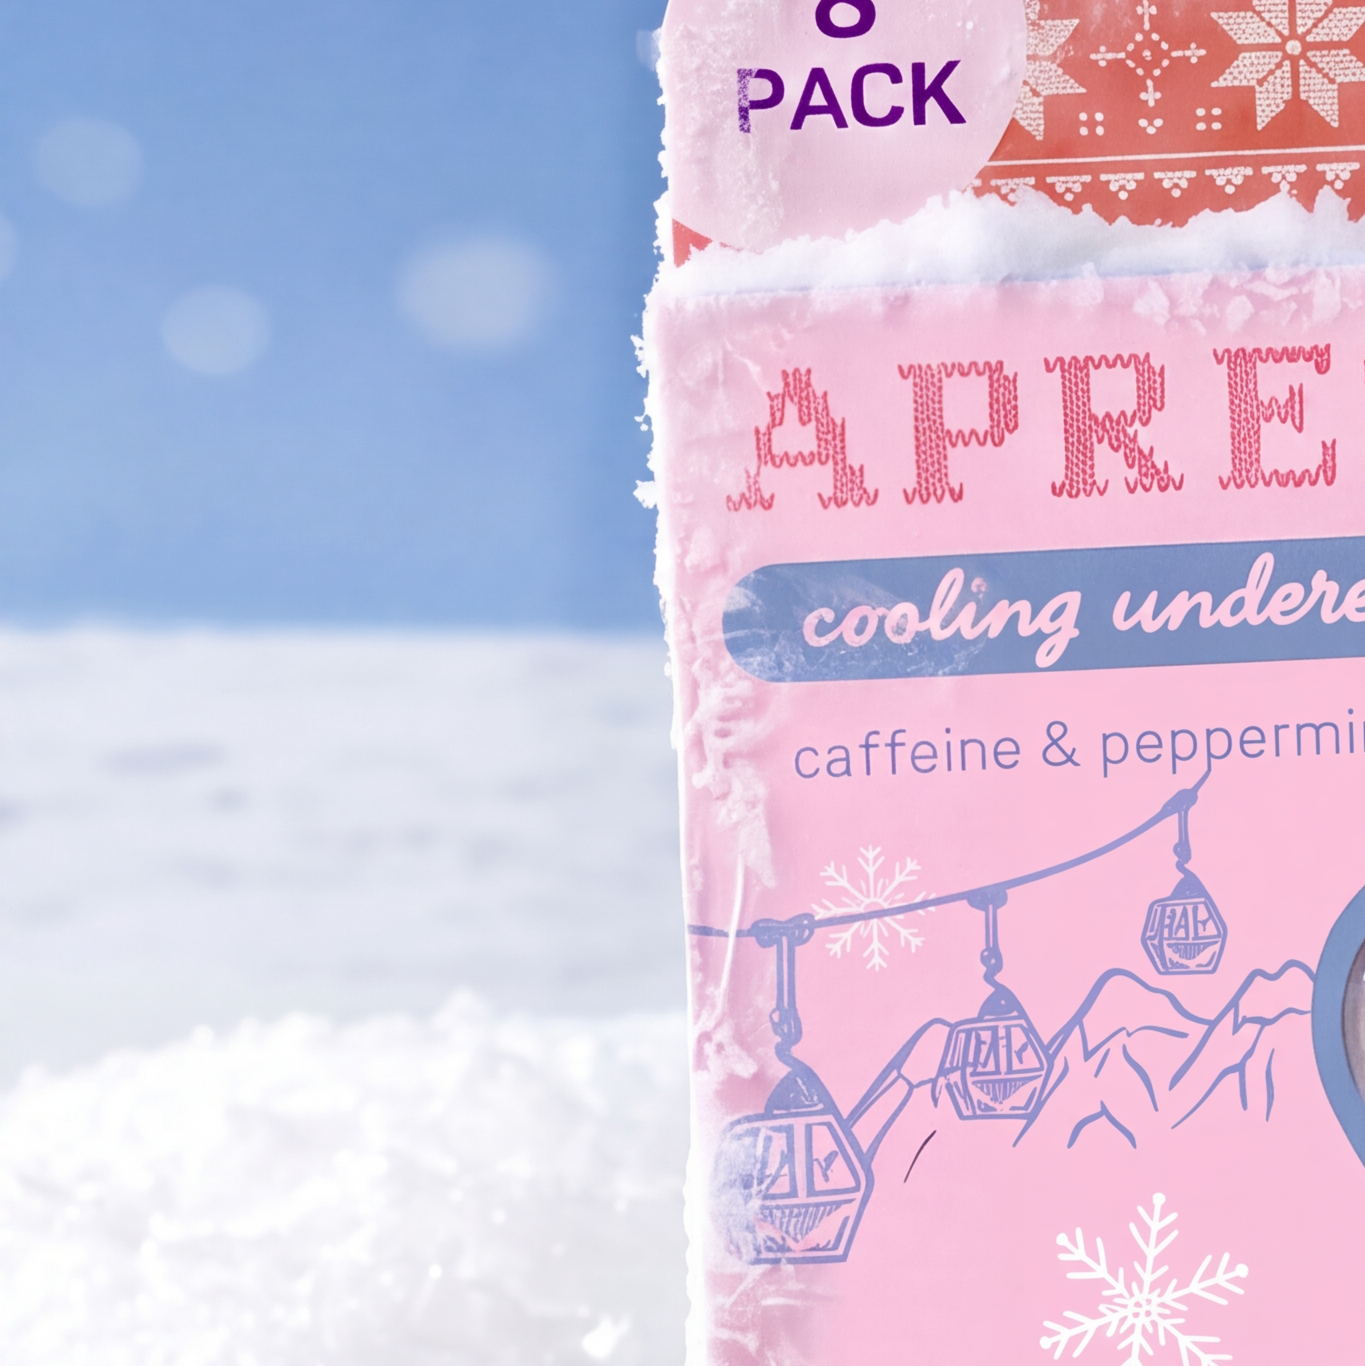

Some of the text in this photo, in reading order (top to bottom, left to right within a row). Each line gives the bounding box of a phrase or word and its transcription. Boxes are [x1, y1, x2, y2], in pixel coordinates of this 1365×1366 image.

[736, 59, 967, 134] PACK
[803, 567, 1082, 669] cooling
[794, 728, 1022, 780] caffeine
[1041, 720, 1081, 769] &
